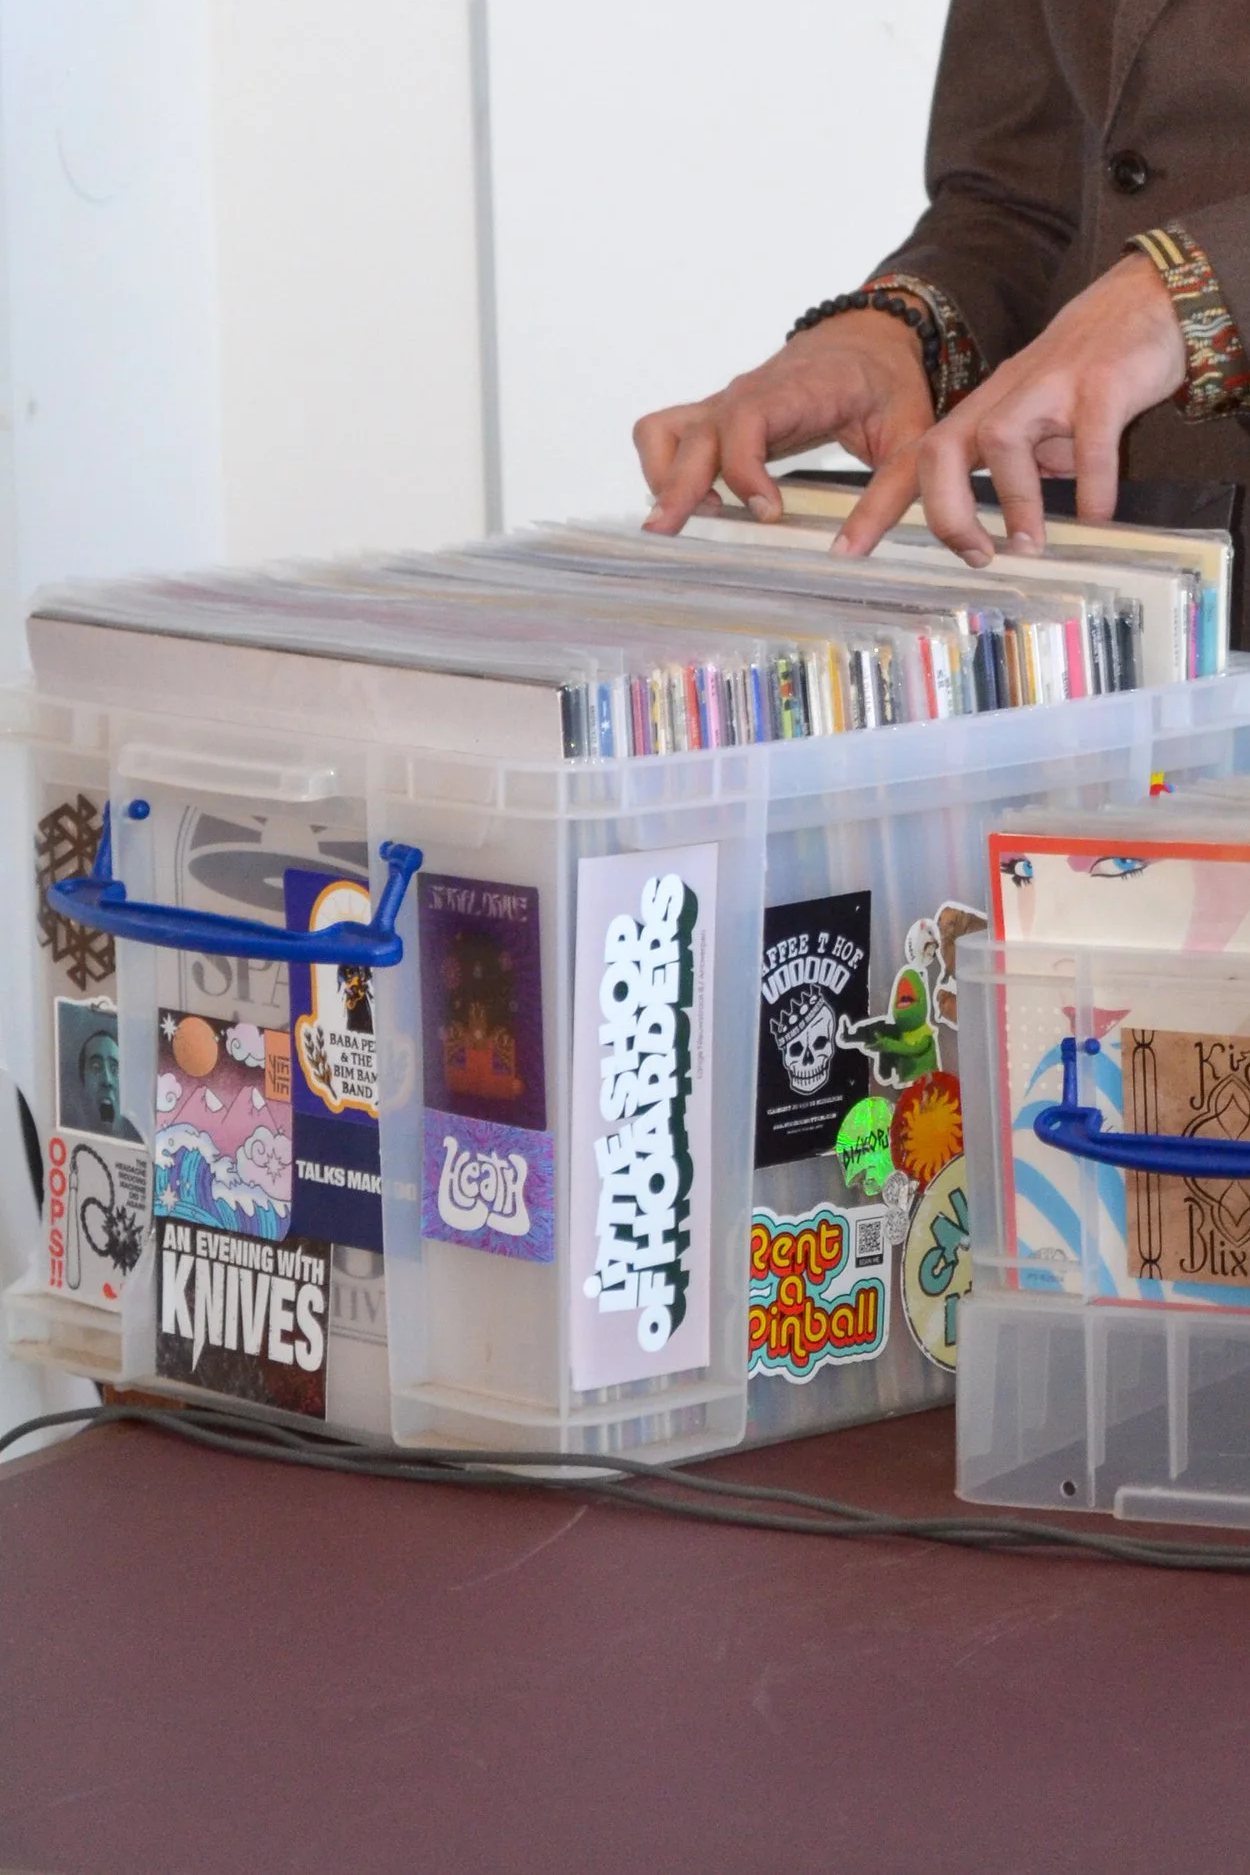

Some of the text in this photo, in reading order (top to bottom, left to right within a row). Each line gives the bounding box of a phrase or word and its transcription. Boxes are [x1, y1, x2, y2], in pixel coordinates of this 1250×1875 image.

[599, 913, 645, 1122] SHOP
[329, 1033, 376, 1054] BABA PE
[340, 1052, 373, 1068] & THE
[333, 1064, 354, 1080] BIM
[342, 1081, 373, 1099] BAND
[630, 873, 686, 1353] OF HOARDERS
[842, 1126, 890, 1170] DISKOPU
[296, 1159, 346, 1188] TALKS
[347, 1171, 382, 1194] MAK
[161, 1223, 325, 1285] AN EVENING WITH
[777, 1274, 806, 1311] a
[161, 1249, 325, 1374] KNIVES
